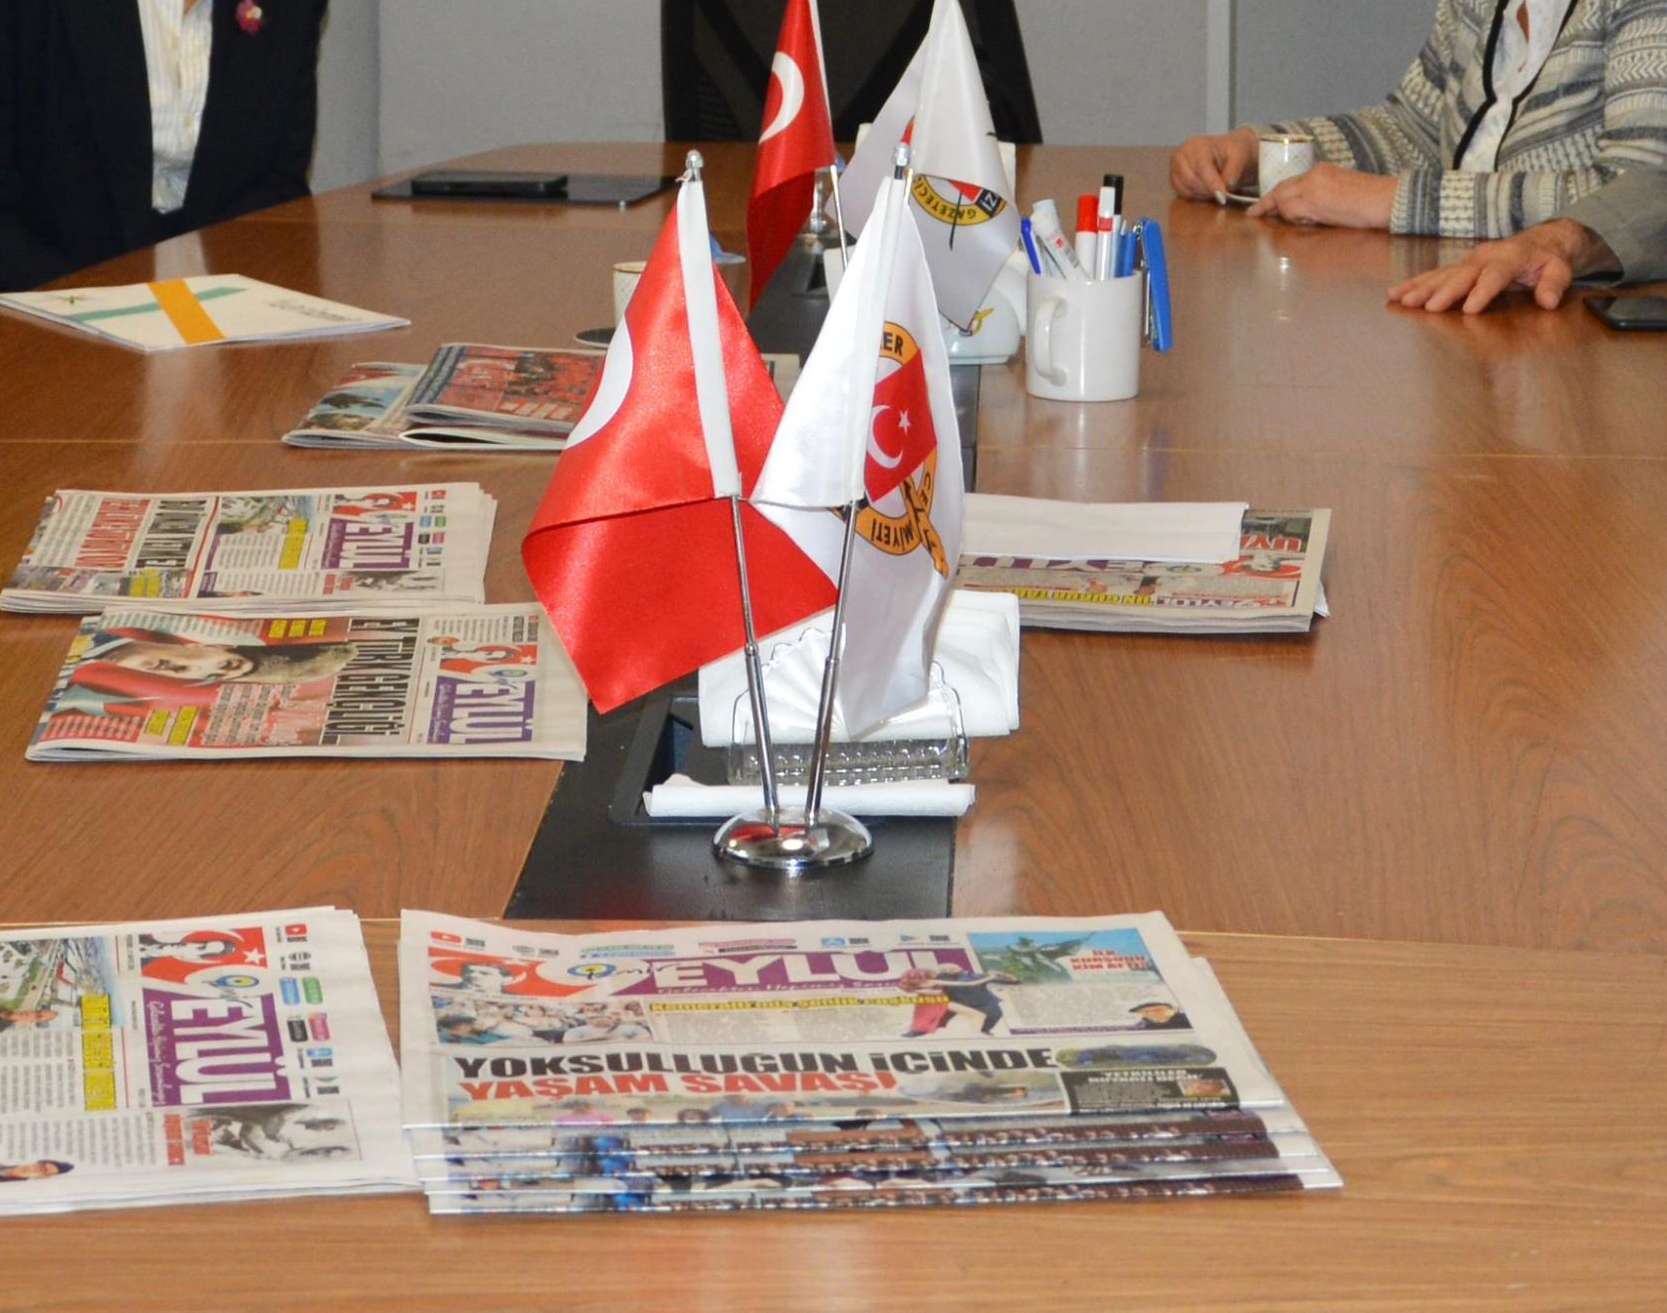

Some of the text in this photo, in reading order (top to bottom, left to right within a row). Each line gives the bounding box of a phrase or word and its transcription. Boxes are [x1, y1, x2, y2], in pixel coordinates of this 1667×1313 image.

[449, 683, 534, 743] EYLÜL
[170, 999, 286, 1104] EYLÜL
[453, 1047, 1060, 1079] YOKSULLUĞUN İÇİNDE
[460, 1070, 898, 1101] YAŞAM SAVAŞI
